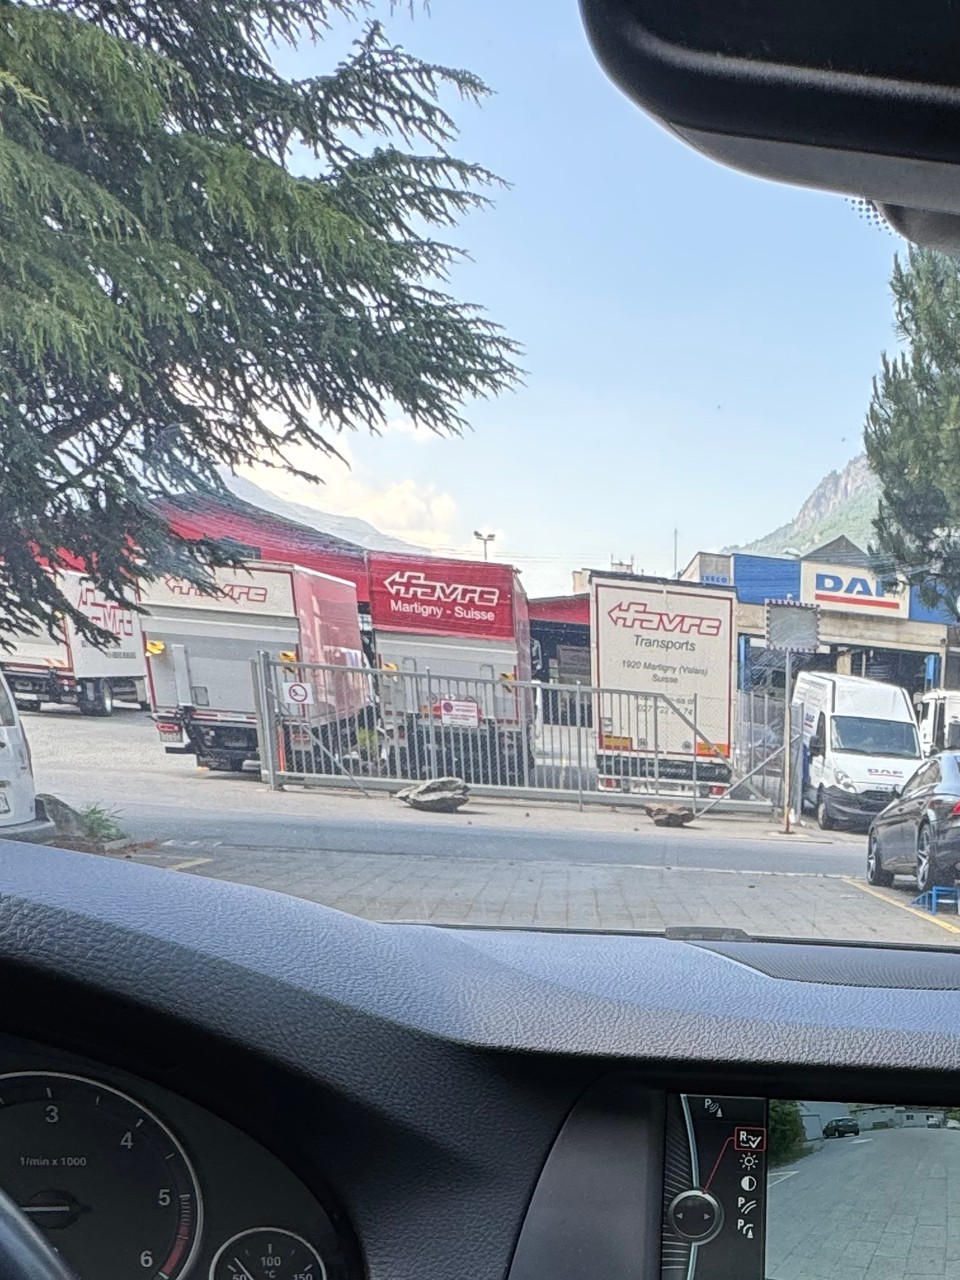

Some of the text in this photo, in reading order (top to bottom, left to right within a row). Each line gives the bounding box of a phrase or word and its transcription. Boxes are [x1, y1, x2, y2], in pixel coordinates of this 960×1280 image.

[390, 600, 443, 619] Martigny
[454, 607, 495, 621] Suisse
[634, 635, 696, 652] Transports
[622, 660, 642, 669] 1920
[643, 661, 678, 674] Martigny
[652, 673, 679, 684] Suisse
[45, 1106, 59, 1123] 3
[120, 1131, 134, 1149] 4
[20, 1157, 50, 1166] 1/min
[61, 1157, 87, 1166] 1000
[158, 1189, 171, 1206] 5
[140, 1250, 153, 1268] 6
[261, 1256, 281, 1267] 100
[264, 1269, 276, 1279] °C
